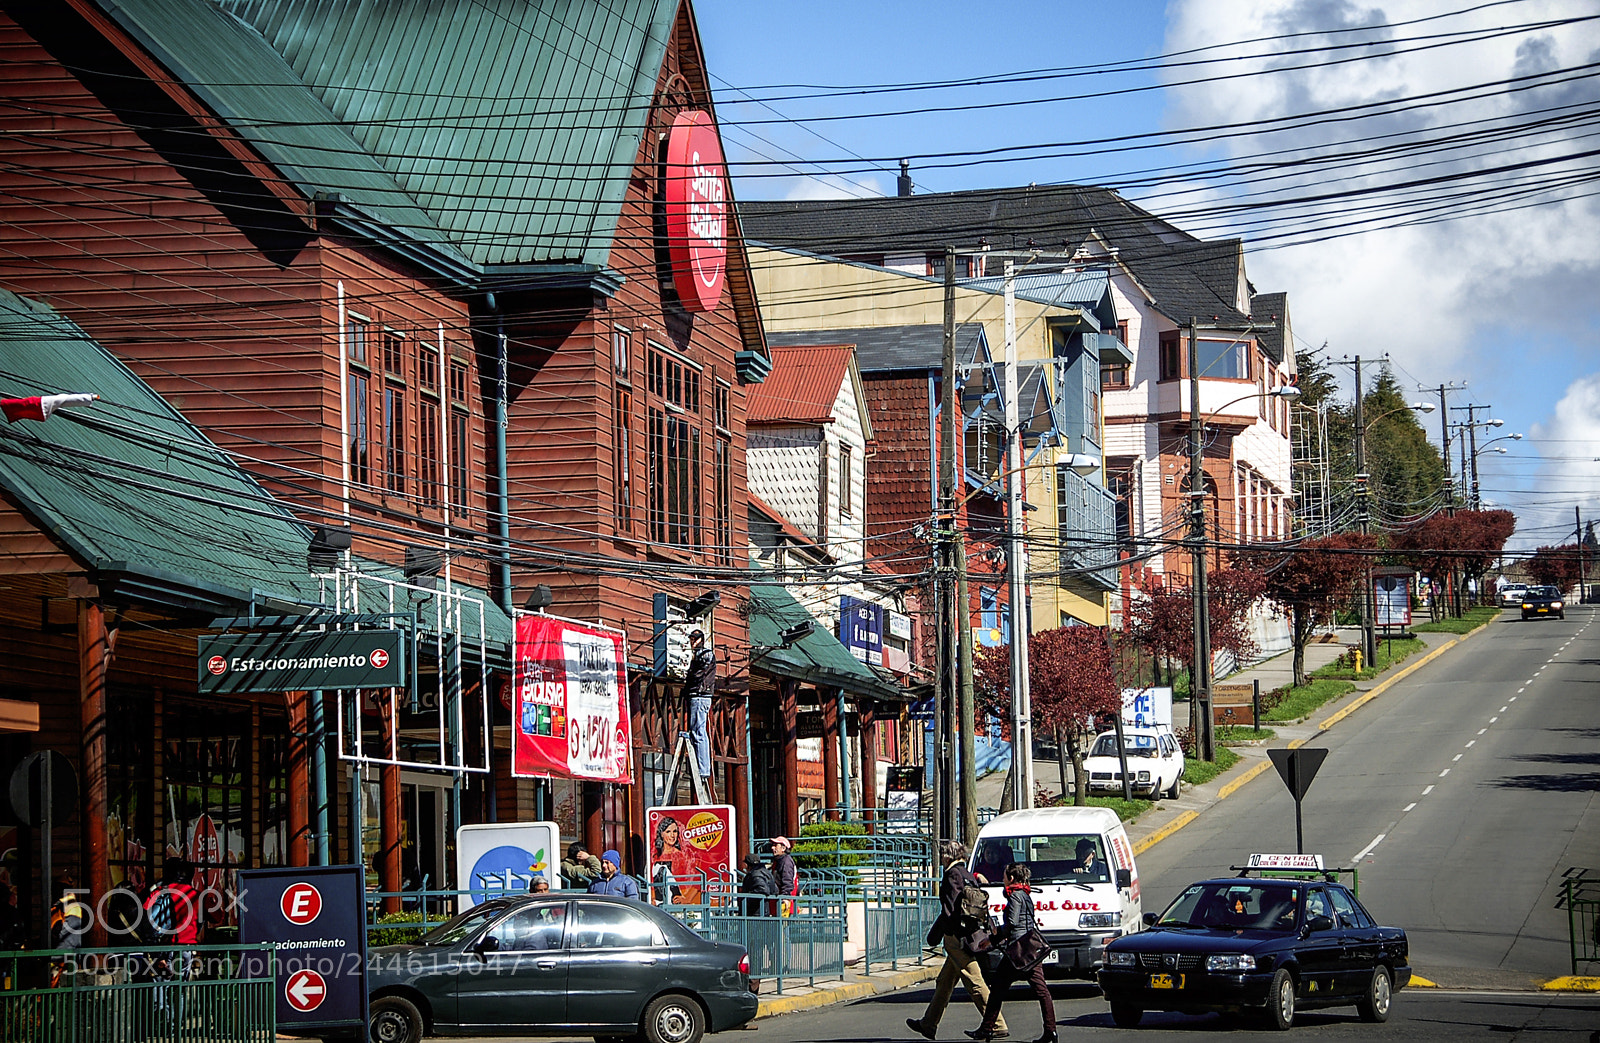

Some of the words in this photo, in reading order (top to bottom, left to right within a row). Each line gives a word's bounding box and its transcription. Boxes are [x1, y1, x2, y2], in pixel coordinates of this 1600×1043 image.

[691, 151, 723, 211] Santa
[690, 192, 723, 253] Isabel
[231, 654, 366, 672] Estacionamiento
[683, 821, 724, 839] OFERTAS
[1251, 854, 1262, 867] 10
[290, 890, 312, 917] E
[1034, 901, 1057, 911] del
[1061, 899, 1101, 911] Sur
